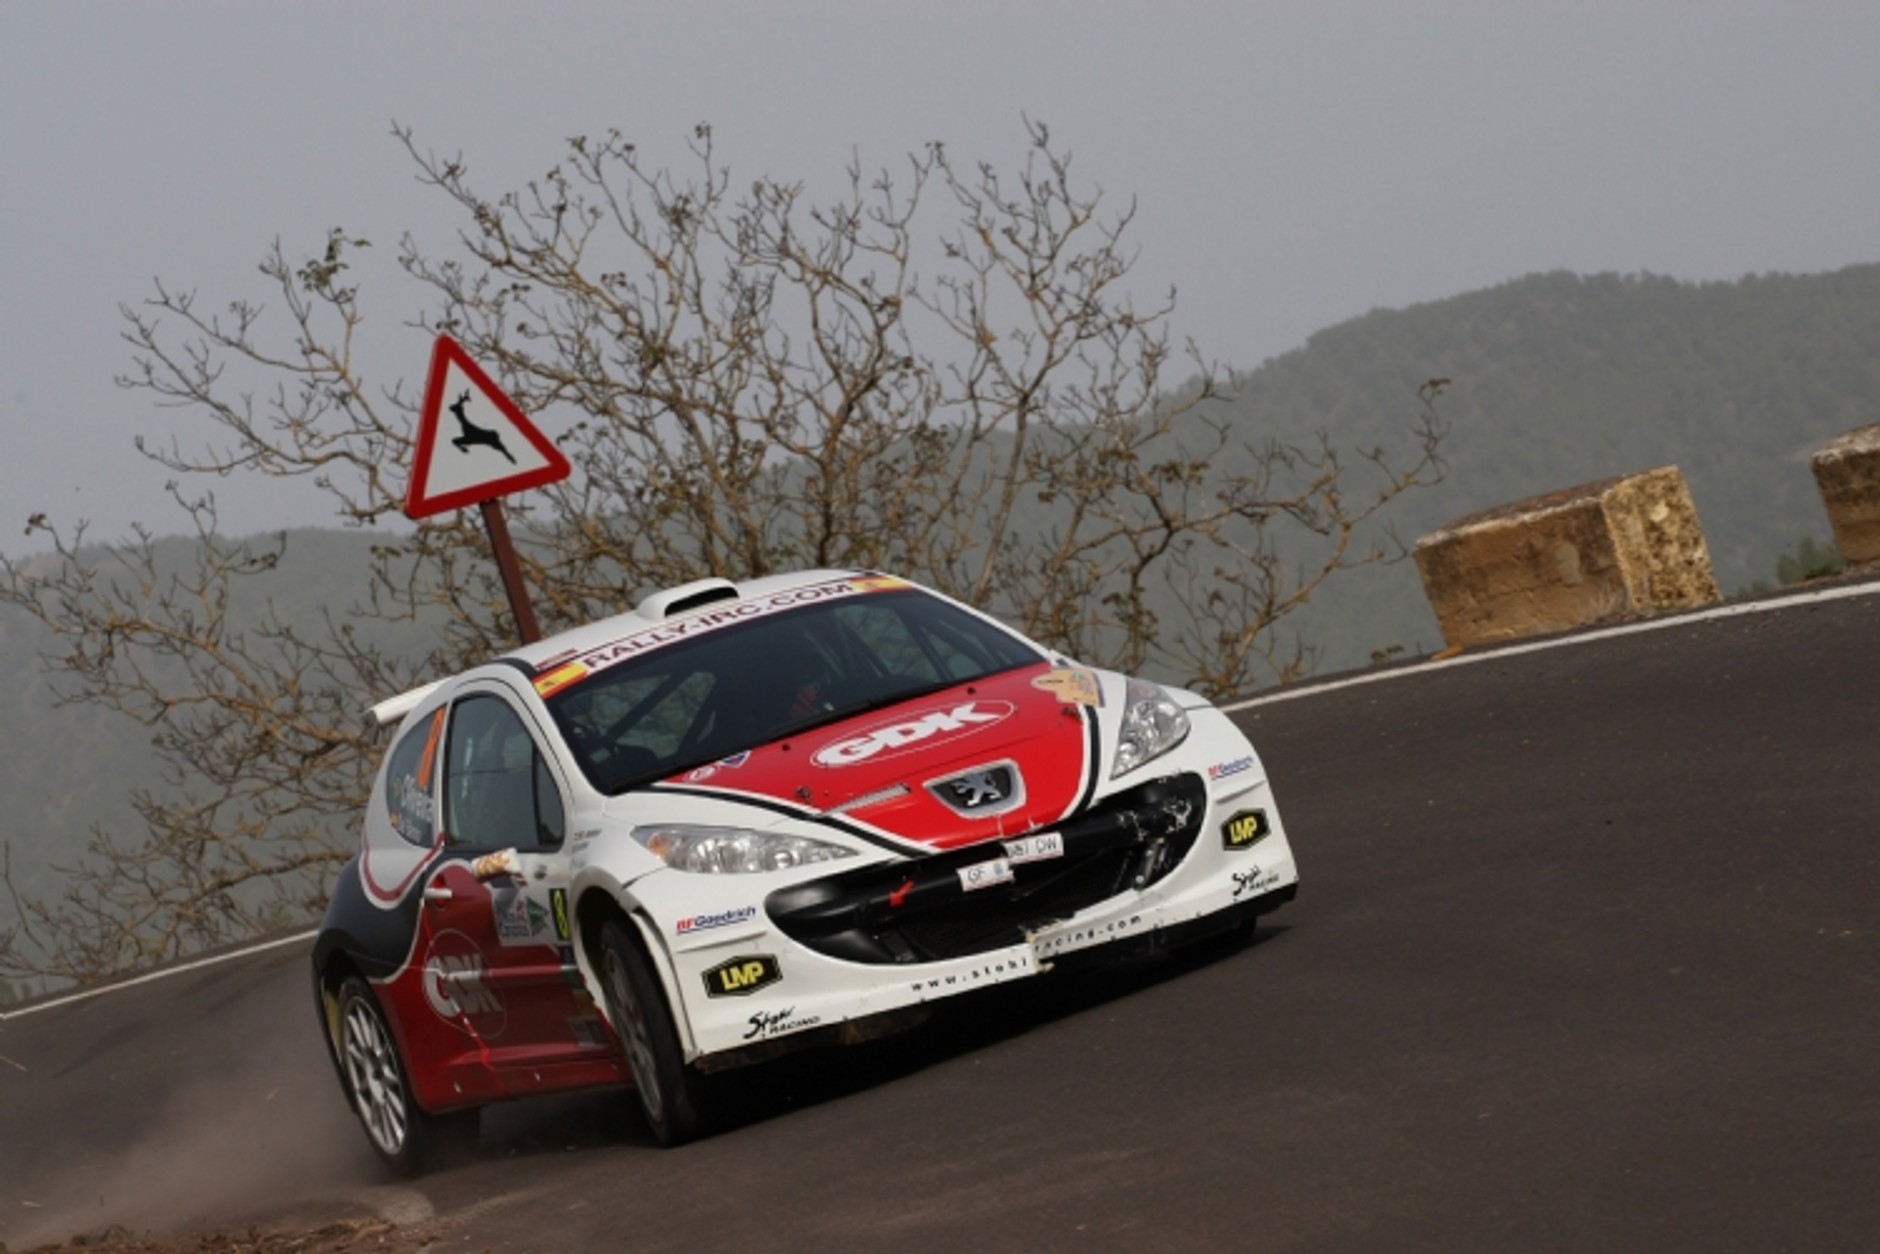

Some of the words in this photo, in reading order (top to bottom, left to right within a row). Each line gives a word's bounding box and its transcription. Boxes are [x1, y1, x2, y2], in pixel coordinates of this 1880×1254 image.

[583, 584, 853, 669] RALLY-IRC.COM
[816, 702, 1000, 766] GDK
[1229, 816, 1258, 844] LMP
[553, 888, 571, 940] 8
[676, 906, 756, 932] BFGoodrich
[719, 961, 764, 991] LMP
[769, 1015, 821, 1034] RACING
